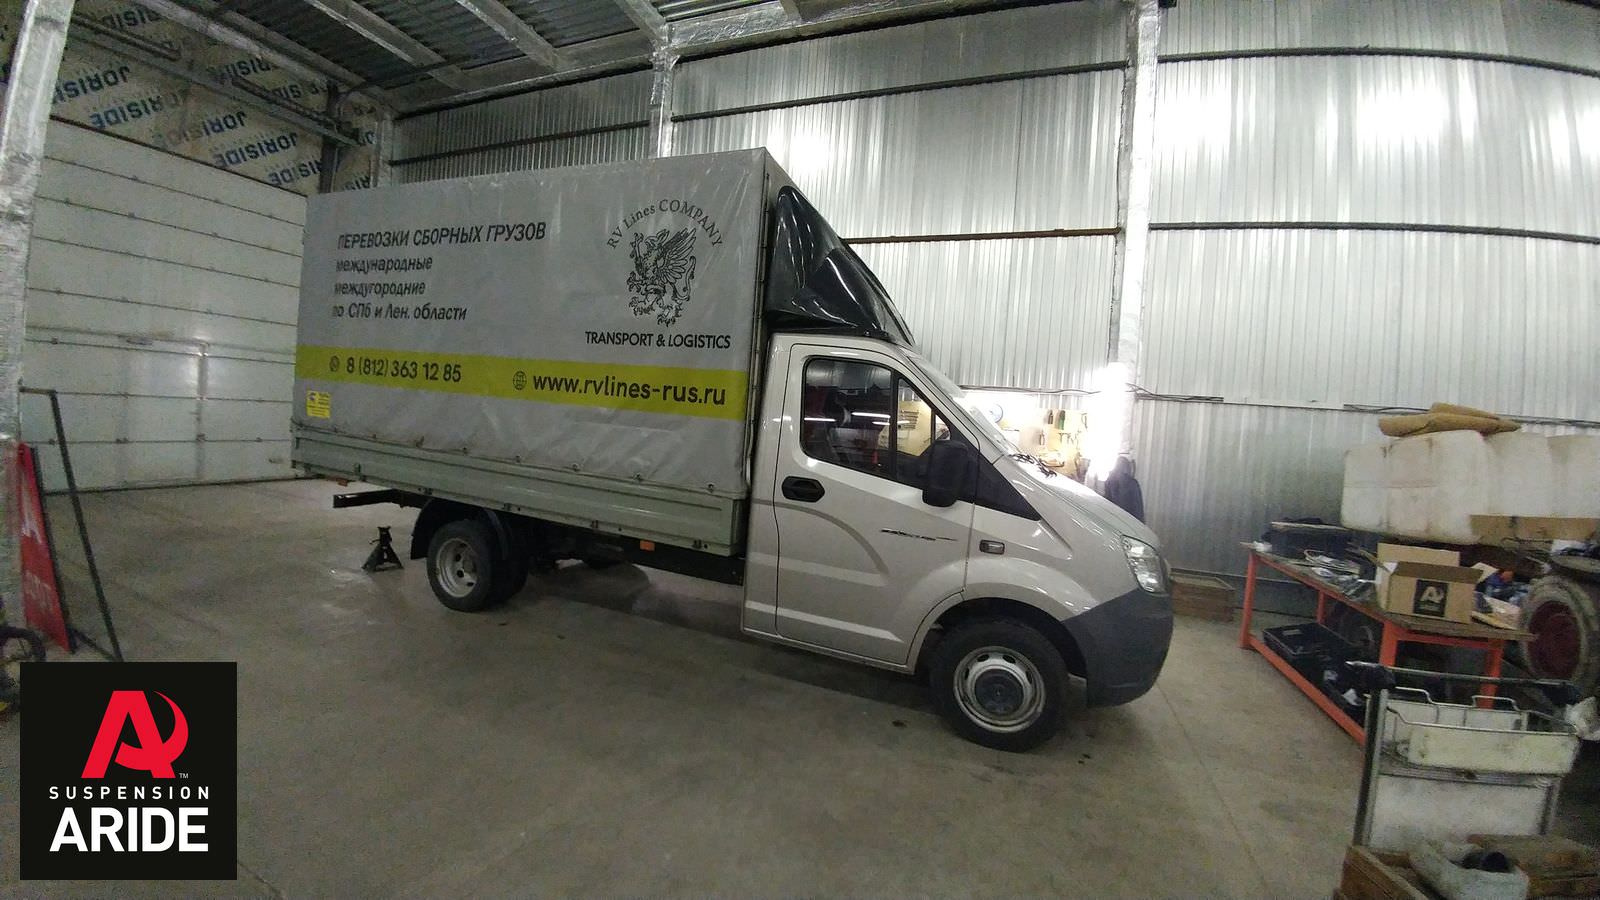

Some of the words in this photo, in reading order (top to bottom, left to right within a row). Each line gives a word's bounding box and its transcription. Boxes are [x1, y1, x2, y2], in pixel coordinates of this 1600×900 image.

[214, 133, 296, 167] JORISIDE
[337, 230, 409, 249] ПЕРЕВОЗКИ
[413, 225, 483, 246] СБОРНЫХ
[486, 222, 547, 242] ГРУЗОВ
[606, 226, 624, 249] RV
[623, 205, 656, 230] Lines
[658, 199, 723, 248] COMPANY
[336, 256, 433, 275] международные
[334, 281, 426, 298] междугородние
[349, 302, 371, 319] СПб
[374, 307, 383, 318] и
[384, 304, 410, 320] Лен.
[414, 303, 467, 321] области
[585, 331, 653, 347] TRANSPORT
[656, 334, 666, 347] &
[668, 334, 731, 349] LOGISTICS
[346, 357, 355, 374] 8
[359, 357, 389, 378] (812)
[391, 361, 418, 379] 363
[422, 363, 439, 381] 12
[443, 364, 462, 383] 85
[533, 375, 727, 406] www.rvlines-rus.ru
